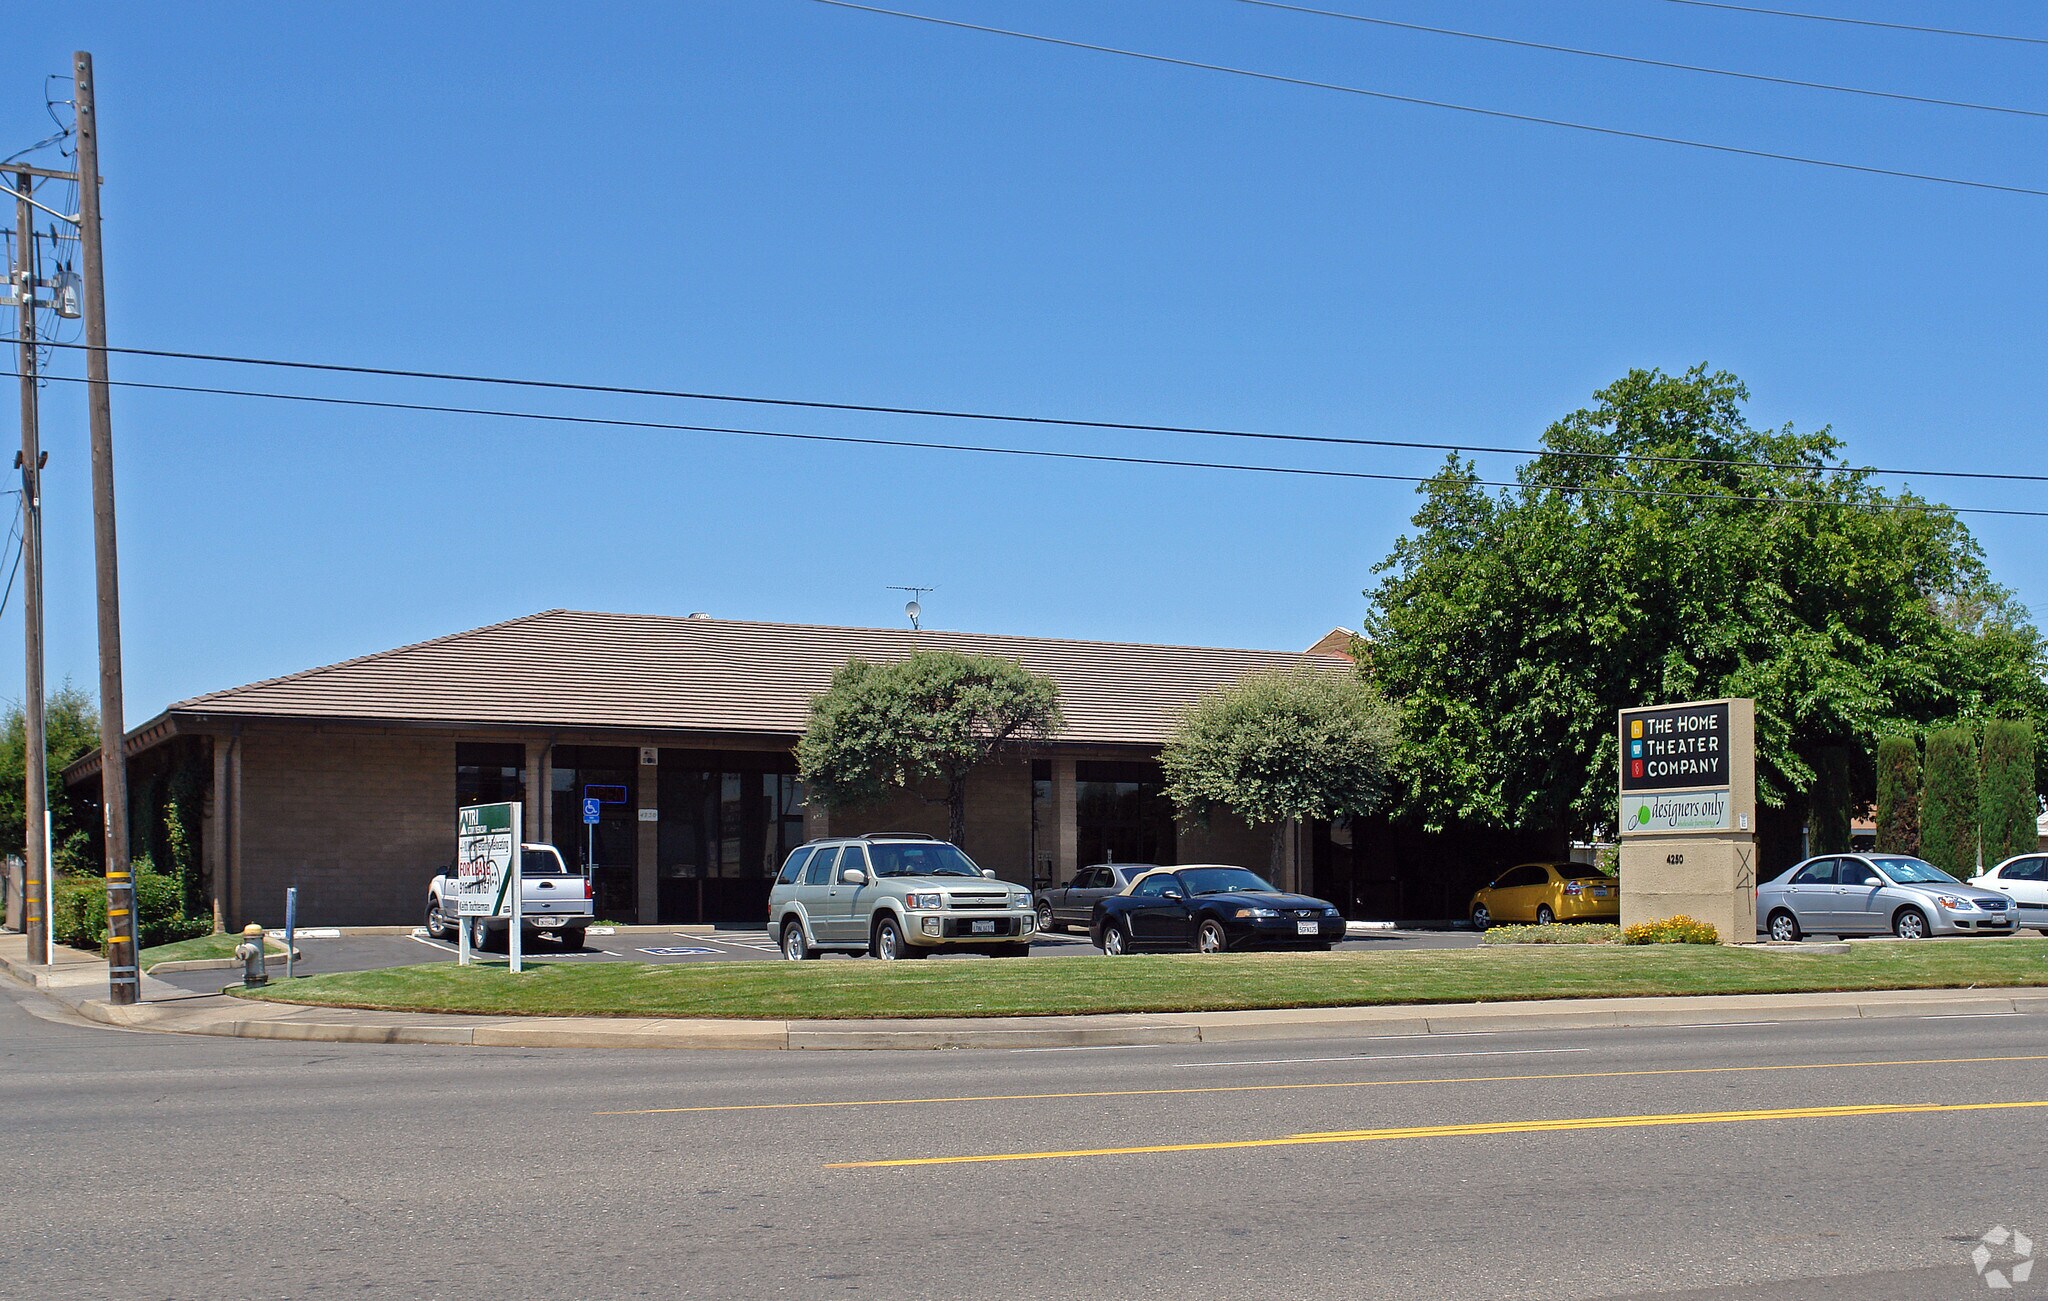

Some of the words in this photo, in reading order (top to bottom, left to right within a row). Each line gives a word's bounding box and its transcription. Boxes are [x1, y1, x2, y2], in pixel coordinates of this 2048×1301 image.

[1647, 718, 1673, 735] THE
[1677, 714, 1718, 733] HOME
[1647, 736, 1719, 756] THEATER
[1647, 757, 1719, 777] COMPANY
[468, 809, 478, 826] TRI
[1652, 795, 1699, 827] designers
[1701, 793, 1724, 825] only
[459, 862, 471, 877] FOR
[1666, 854, 1684, 865] 4250
